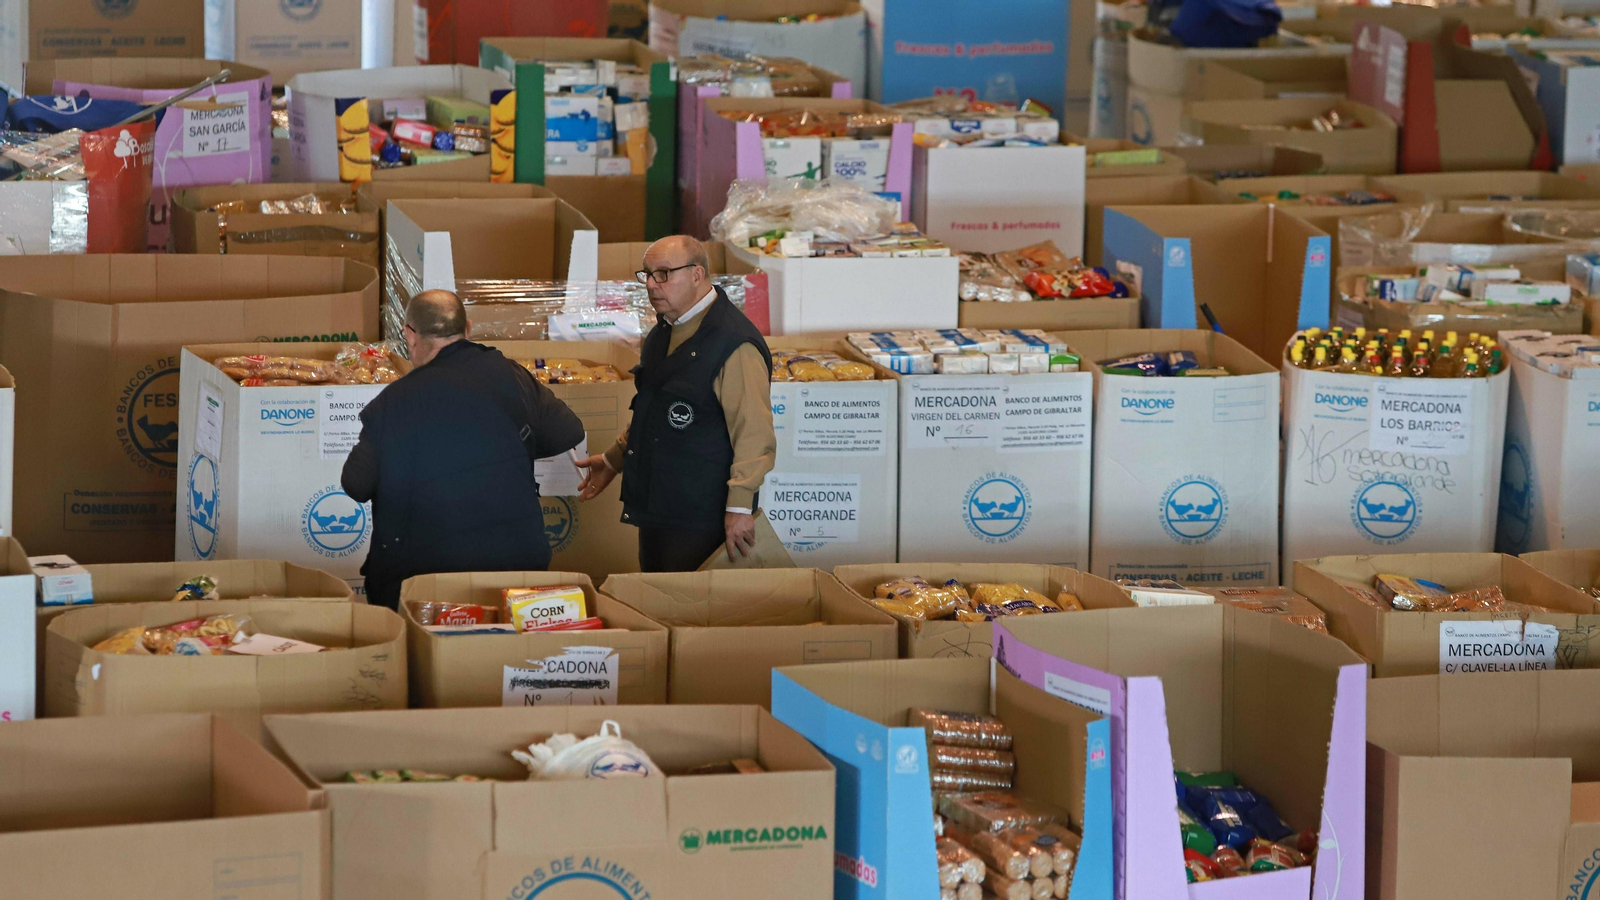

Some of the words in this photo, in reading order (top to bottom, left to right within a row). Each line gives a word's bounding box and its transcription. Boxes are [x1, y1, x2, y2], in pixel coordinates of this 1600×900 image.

[189, 125, 210, 137] SAN
[212, 119, 245, 135] GARCÍA
[157, 356, 176, 369] DE
[329, 402, 354, 410] BANCO
[842, 400, 880, 408] ALIMENTOS
[914, 396, 997, 408] MERCADONA
[1005, 396, 1030, 404] BANCO
[1381, 400, 1462, 414] MERCADONA
[329, 414, 356, 422] CAMPO
[804, 412, 830, 420] CAMPO
[832, 412, 841, 420] DE
[843, 412, 880, 420] GIBRALTAR
[911, 412, 943, 420] VIRGEN
[945, 412, 962, 420] DEL
[964, 412, 1000, 420] CARMEN
[1381, 418, 1404, 430] LOS
[926, 426, 940, 437] Nº
[962, 476, 984, 505] BANCOS
[998, 472, 1032, 503] ALIMENTOS
[1159, 478, 1182, 506] BANCOS
[1197, 474, 1229, 505] ALIMENTOS
[774, 491, 852, 502] MERCADONA
[71, 503, 158, 515] CONSERVAS
[302, 489, 324, 519] BANCOS
[768, 509, 856, 521] SOTOGRANDE
[790, 528, 801, 536] Nº
[962, 514, 984, 541] BANCOS
[998, 512, 1032, 544] ALIMENTOS
[1159, 514, 1181, 542] BANCOS
[1195, 513, 1229, 544] ALIMENTOS
[302, 527, 324, 555] BANCOS
[338, 524, 372, 558] ALIMENTOS
[793, 544, 804, 552] DE
[1114, 574, 1177, 582] CONSERVAS
[1186, 573, 1222, 582] ACEITE
[1232, 571, 1265, 581] LECHE
[440, 615, 477, 626] María
[1448, 644, 1545, 657] MERCADONA
[1446, 664, 1458, 674] C/
[1461, 662, 1516, 672] CLAVEL-LA
[1518, 661, 1547, 672] LÍNEA
[524, 694, 542, 706] Nº
[706, 825, 828, 845] MERCADONA
[550, 856, 574, 874] DE
